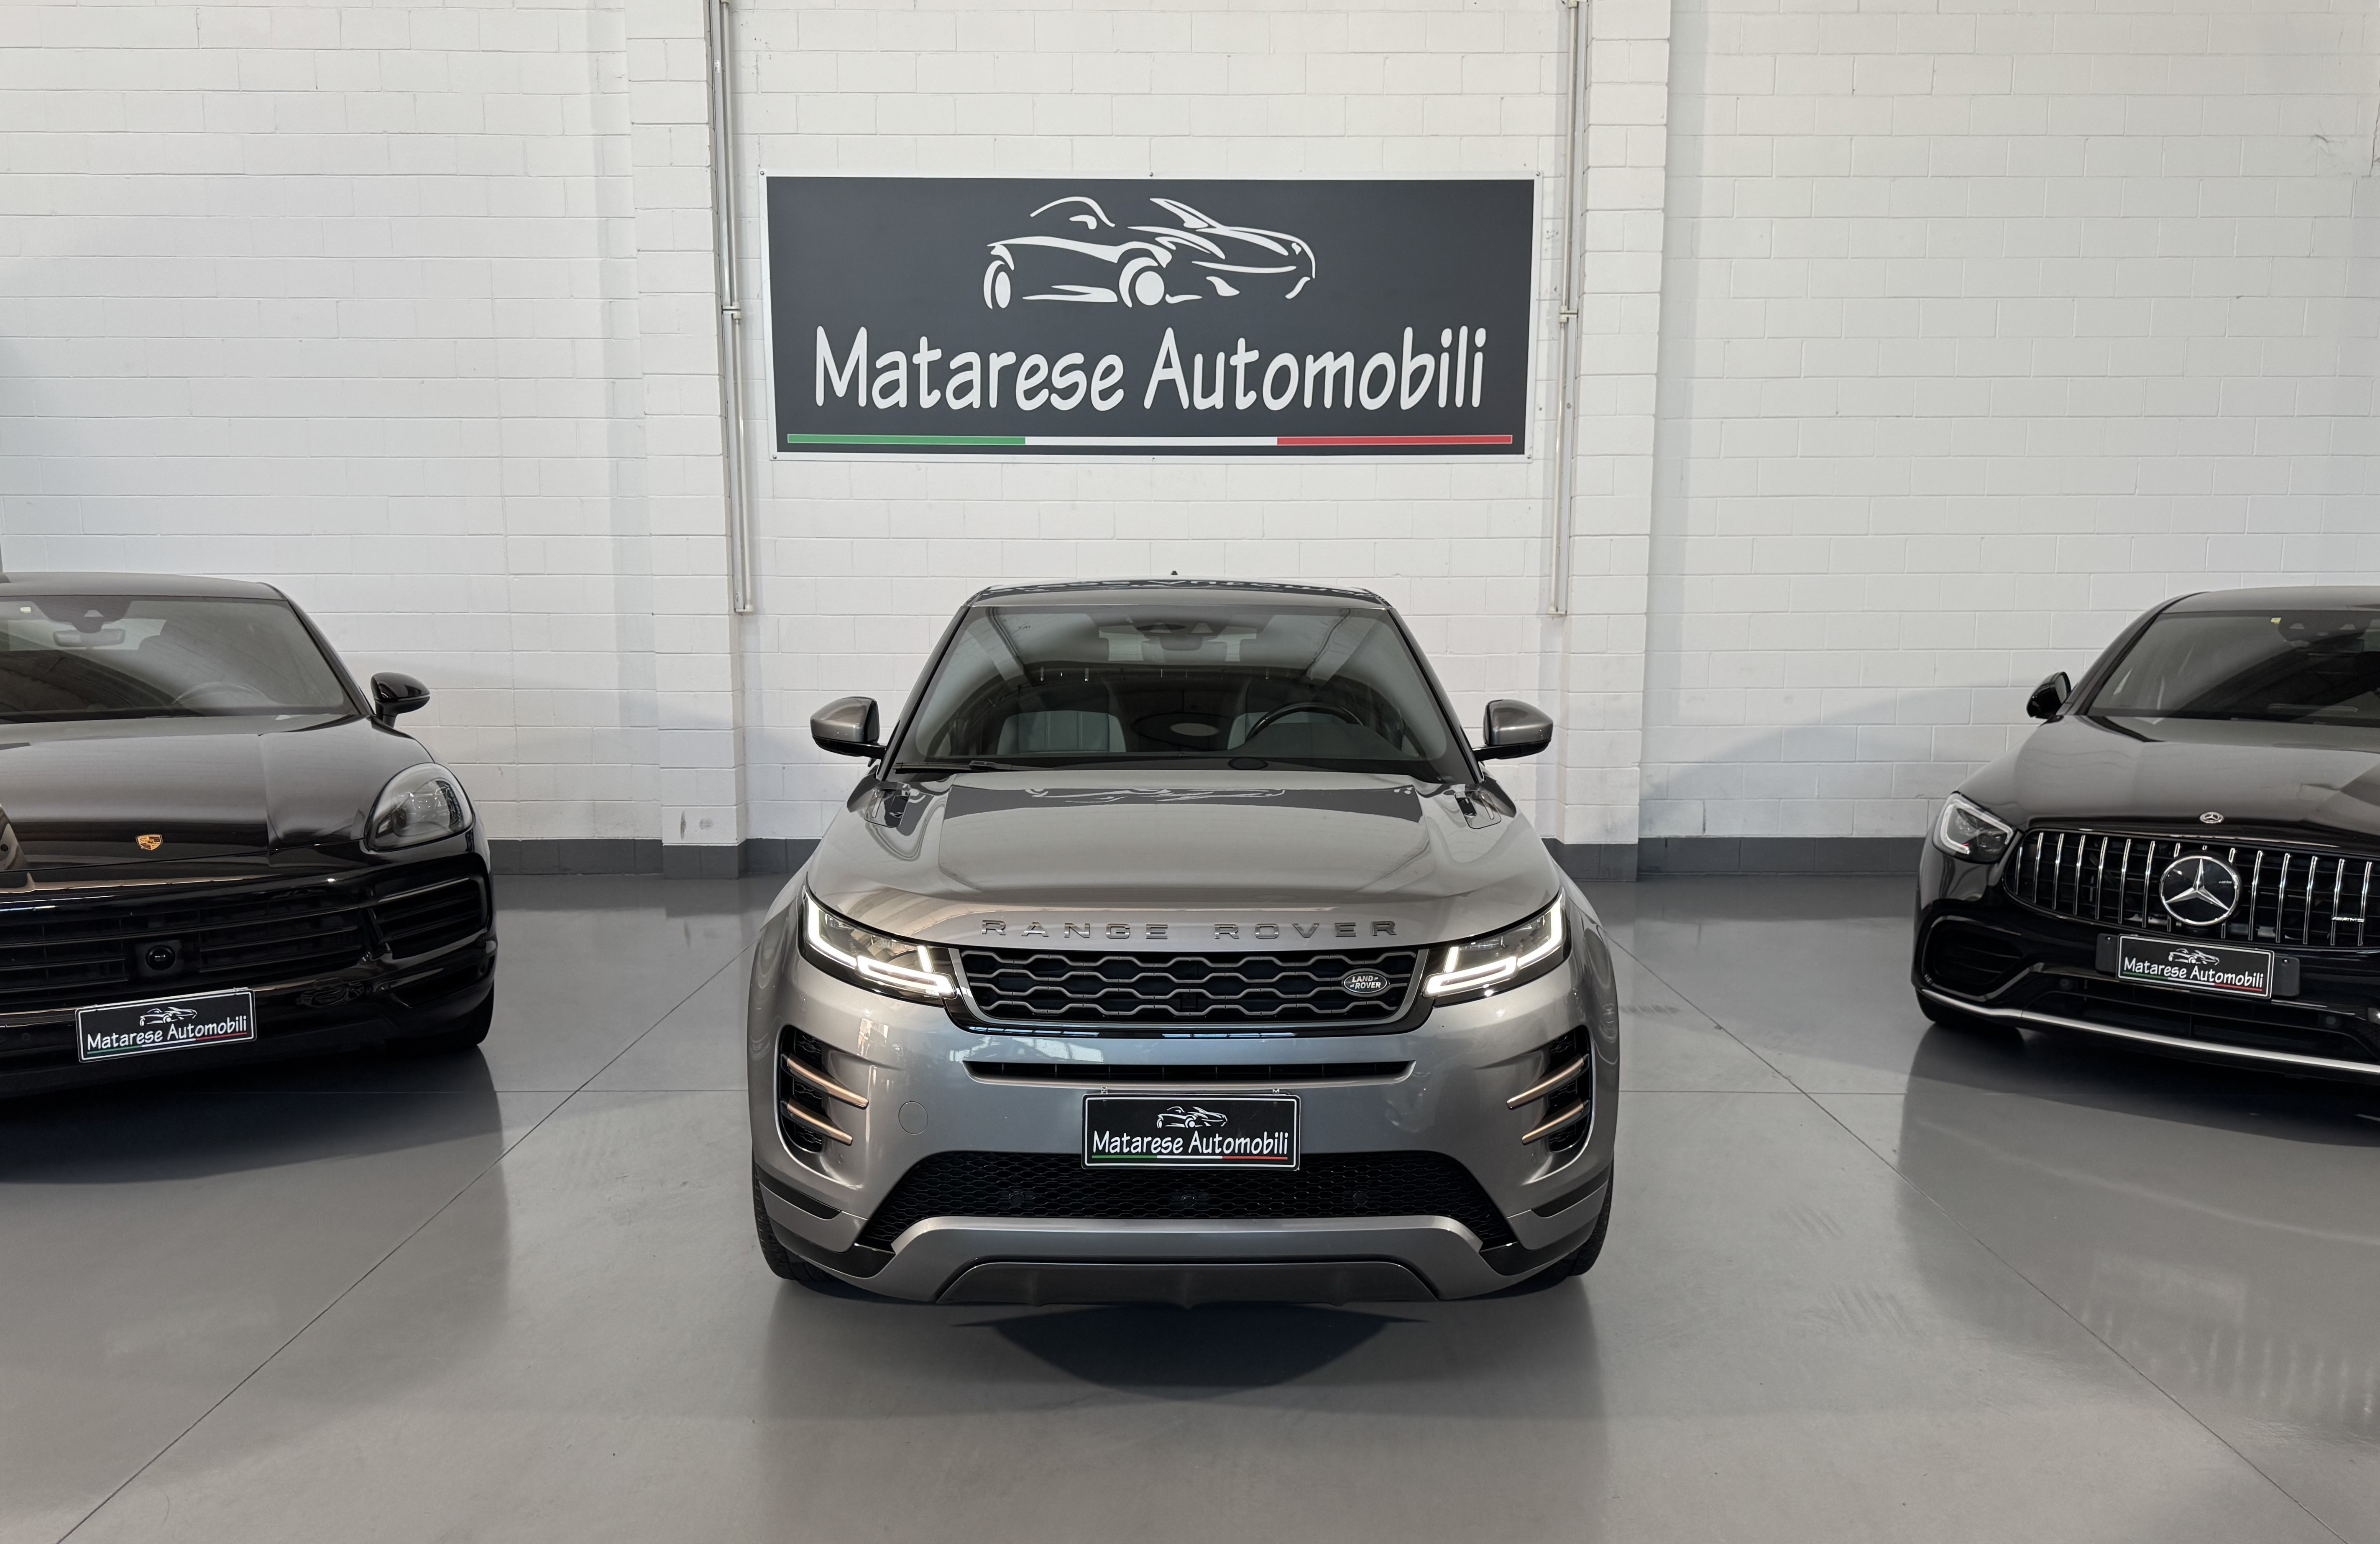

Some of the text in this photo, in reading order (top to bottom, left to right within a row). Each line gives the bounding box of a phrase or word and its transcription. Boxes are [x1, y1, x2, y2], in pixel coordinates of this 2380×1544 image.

[815, 325, 1486, 411] Matarese Automobili
[981, 919, 1397, 939] RANGE ROVER
[2124, 957, 2264, 988] Matarese Automobili
[87, 1015, 247, 1050] Matarese Automobili
[1093, 1130, 1288, 1154] Matarese Automobili
